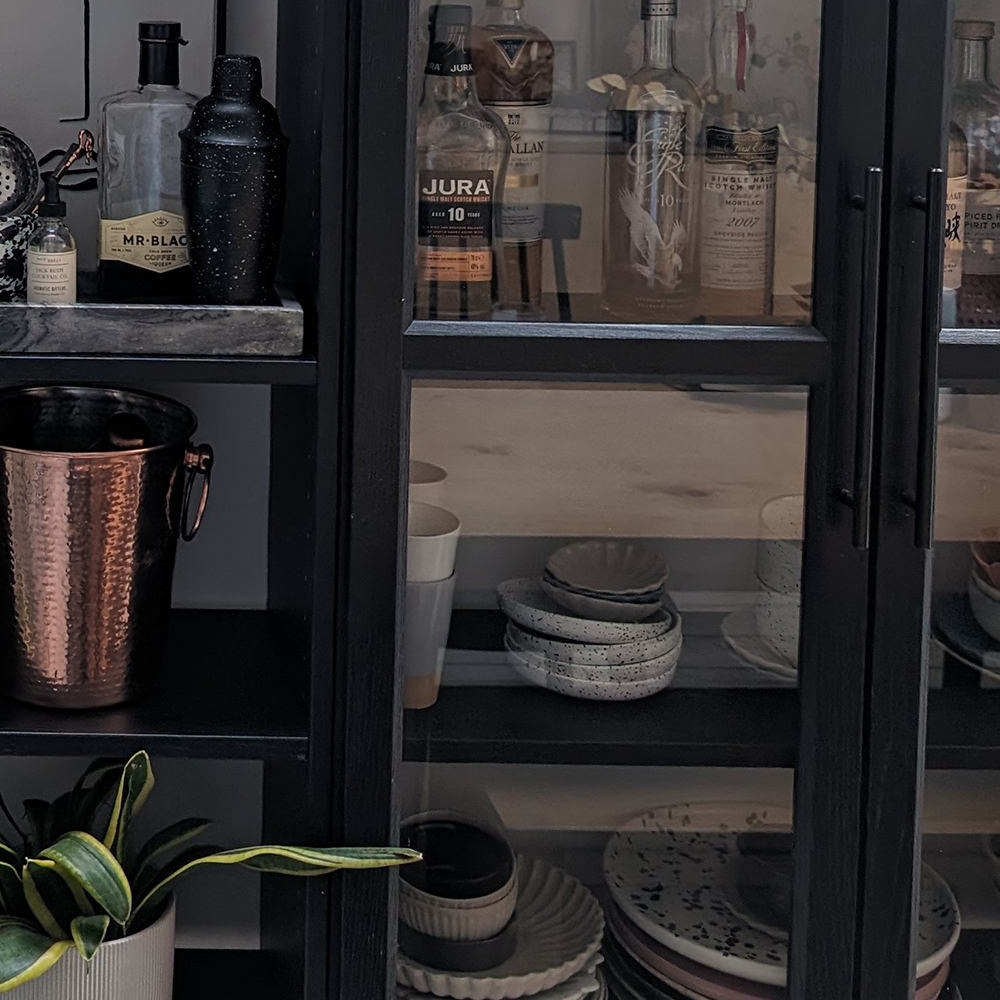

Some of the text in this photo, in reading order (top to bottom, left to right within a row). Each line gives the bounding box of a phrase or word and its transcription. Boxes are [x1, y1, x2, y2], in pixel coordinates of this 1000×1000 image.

[450, 64, 474, 73] JURA
[711, 175, 773, 184] SINGLE MALT
[421, 179, 491, 196] JURA
[660, 194, 675, 208] 10
[447, 207, 465, 222] 10
[726, 217, 760, 228] 2007
